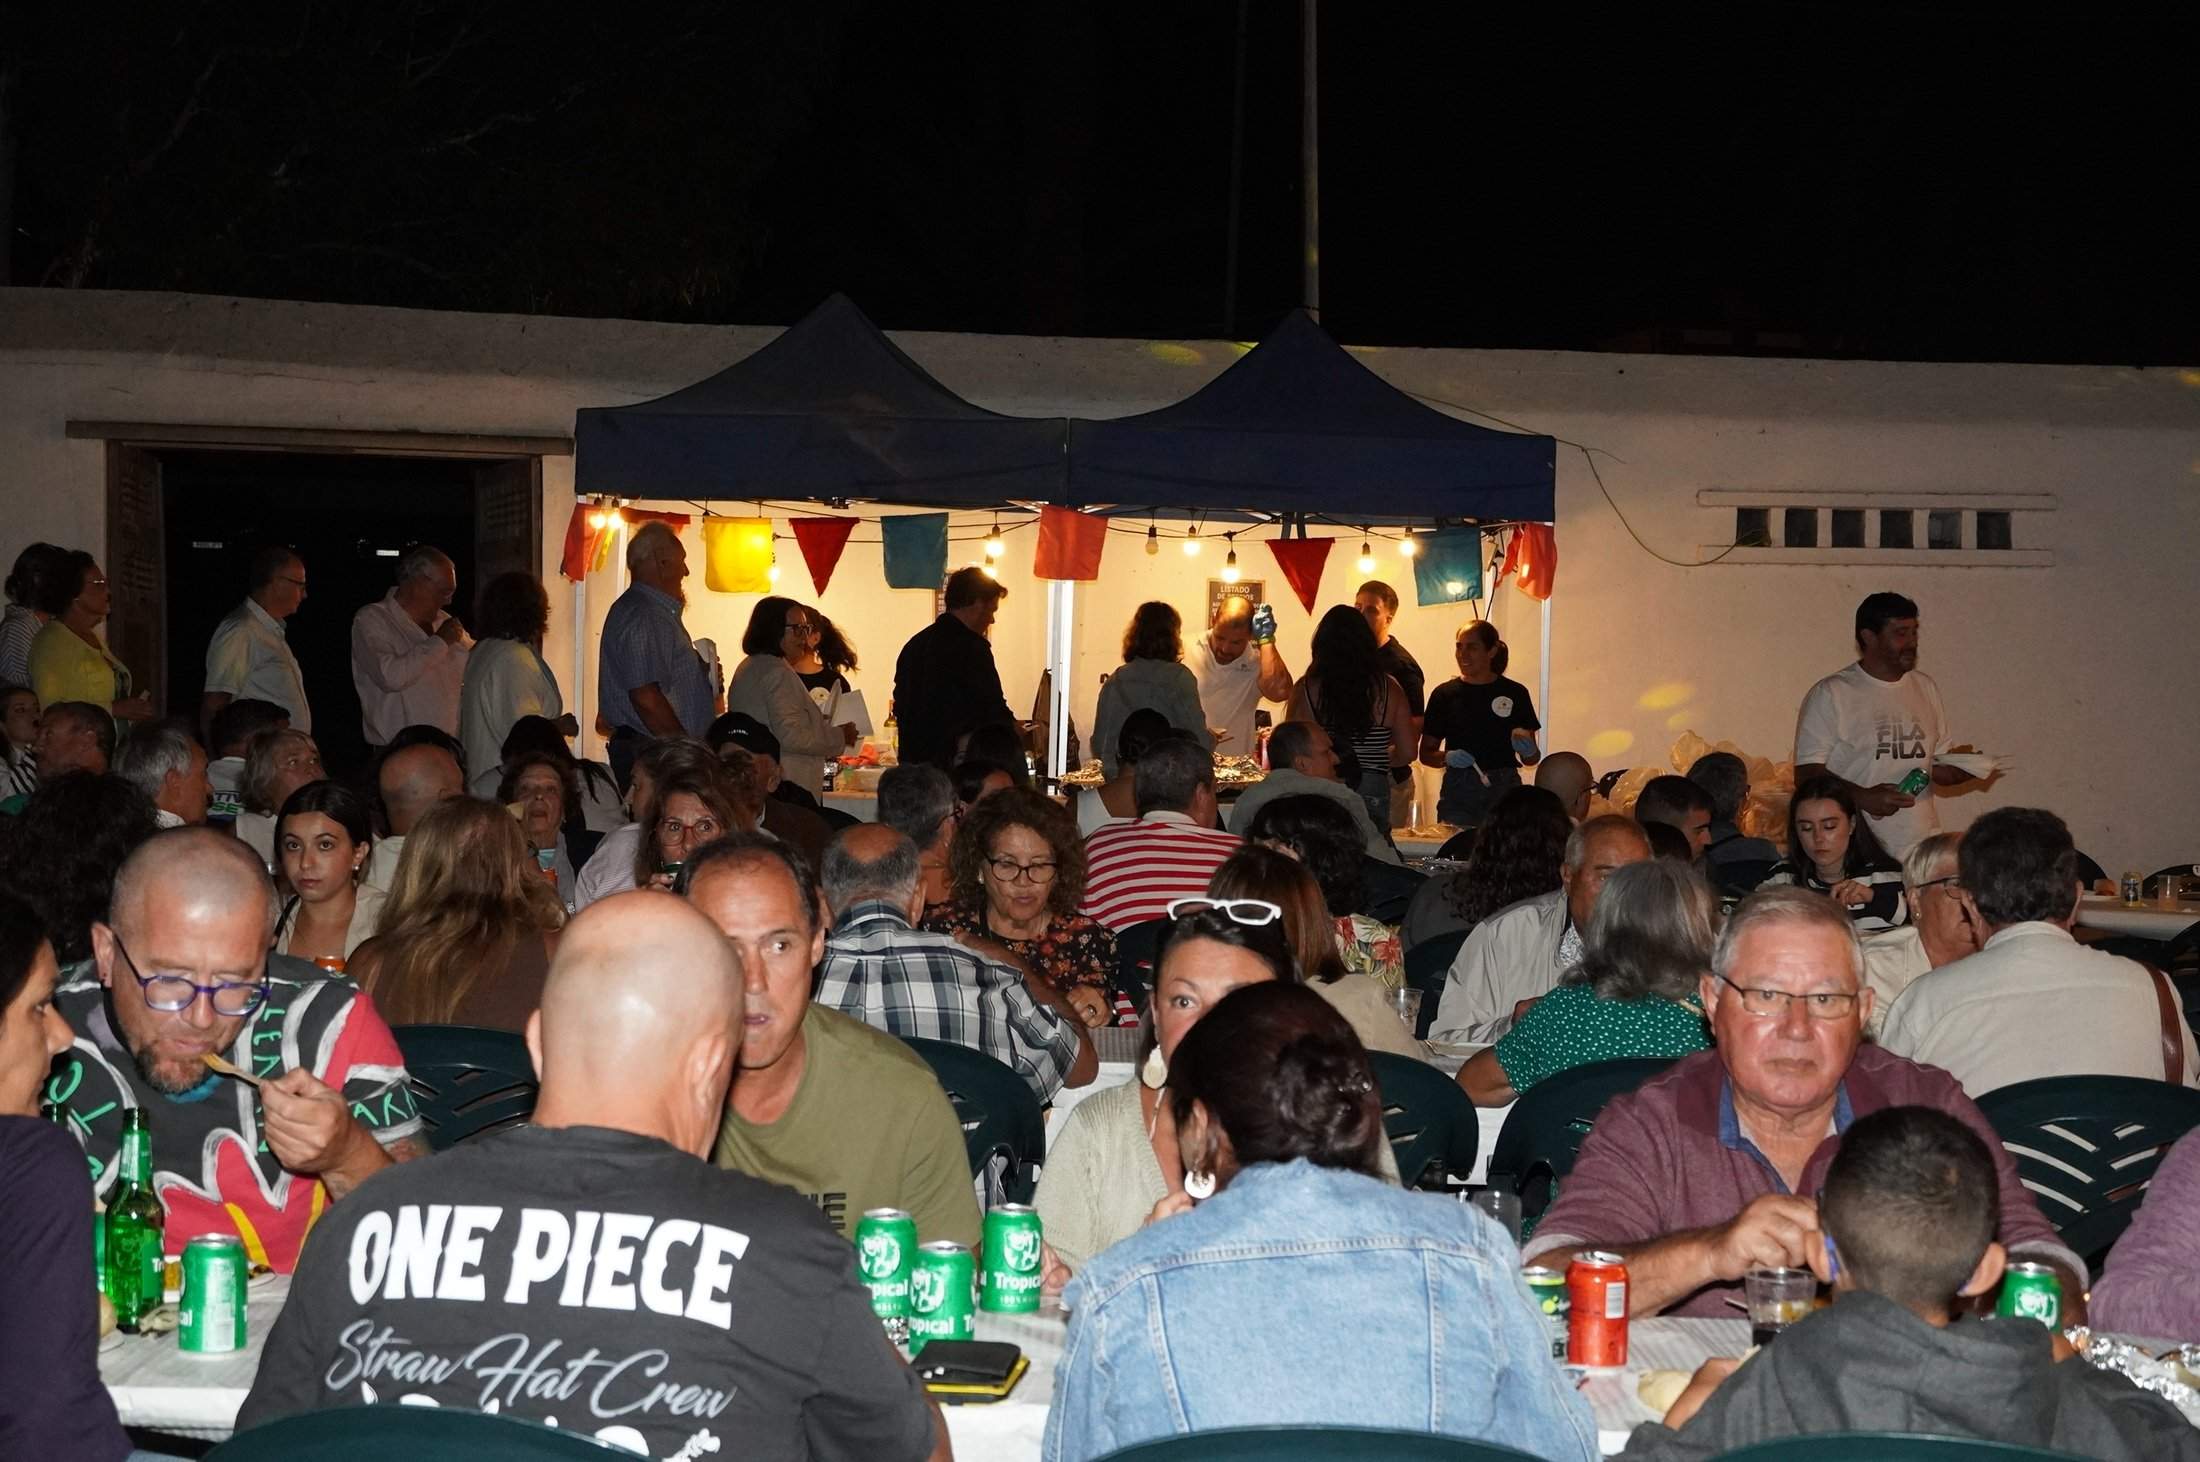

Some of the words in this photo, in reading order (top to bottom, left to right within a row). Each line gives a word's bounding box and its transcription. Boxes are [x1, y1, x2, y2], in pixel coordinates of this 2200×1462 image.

[1220, 585, 1250, 594] LISTADO
[1876, 741, 1926, 760] FILA
[348, 1204, 503, 1305] ONE
[503, 1207, 750, 1330] PIECE
[863, 1279, 908, 1300] pical
[325, 1318, 467, 1392] Straw
[464, 1332, 620, 1408] Hat
[588, 1348, 738, 1419] Crew
